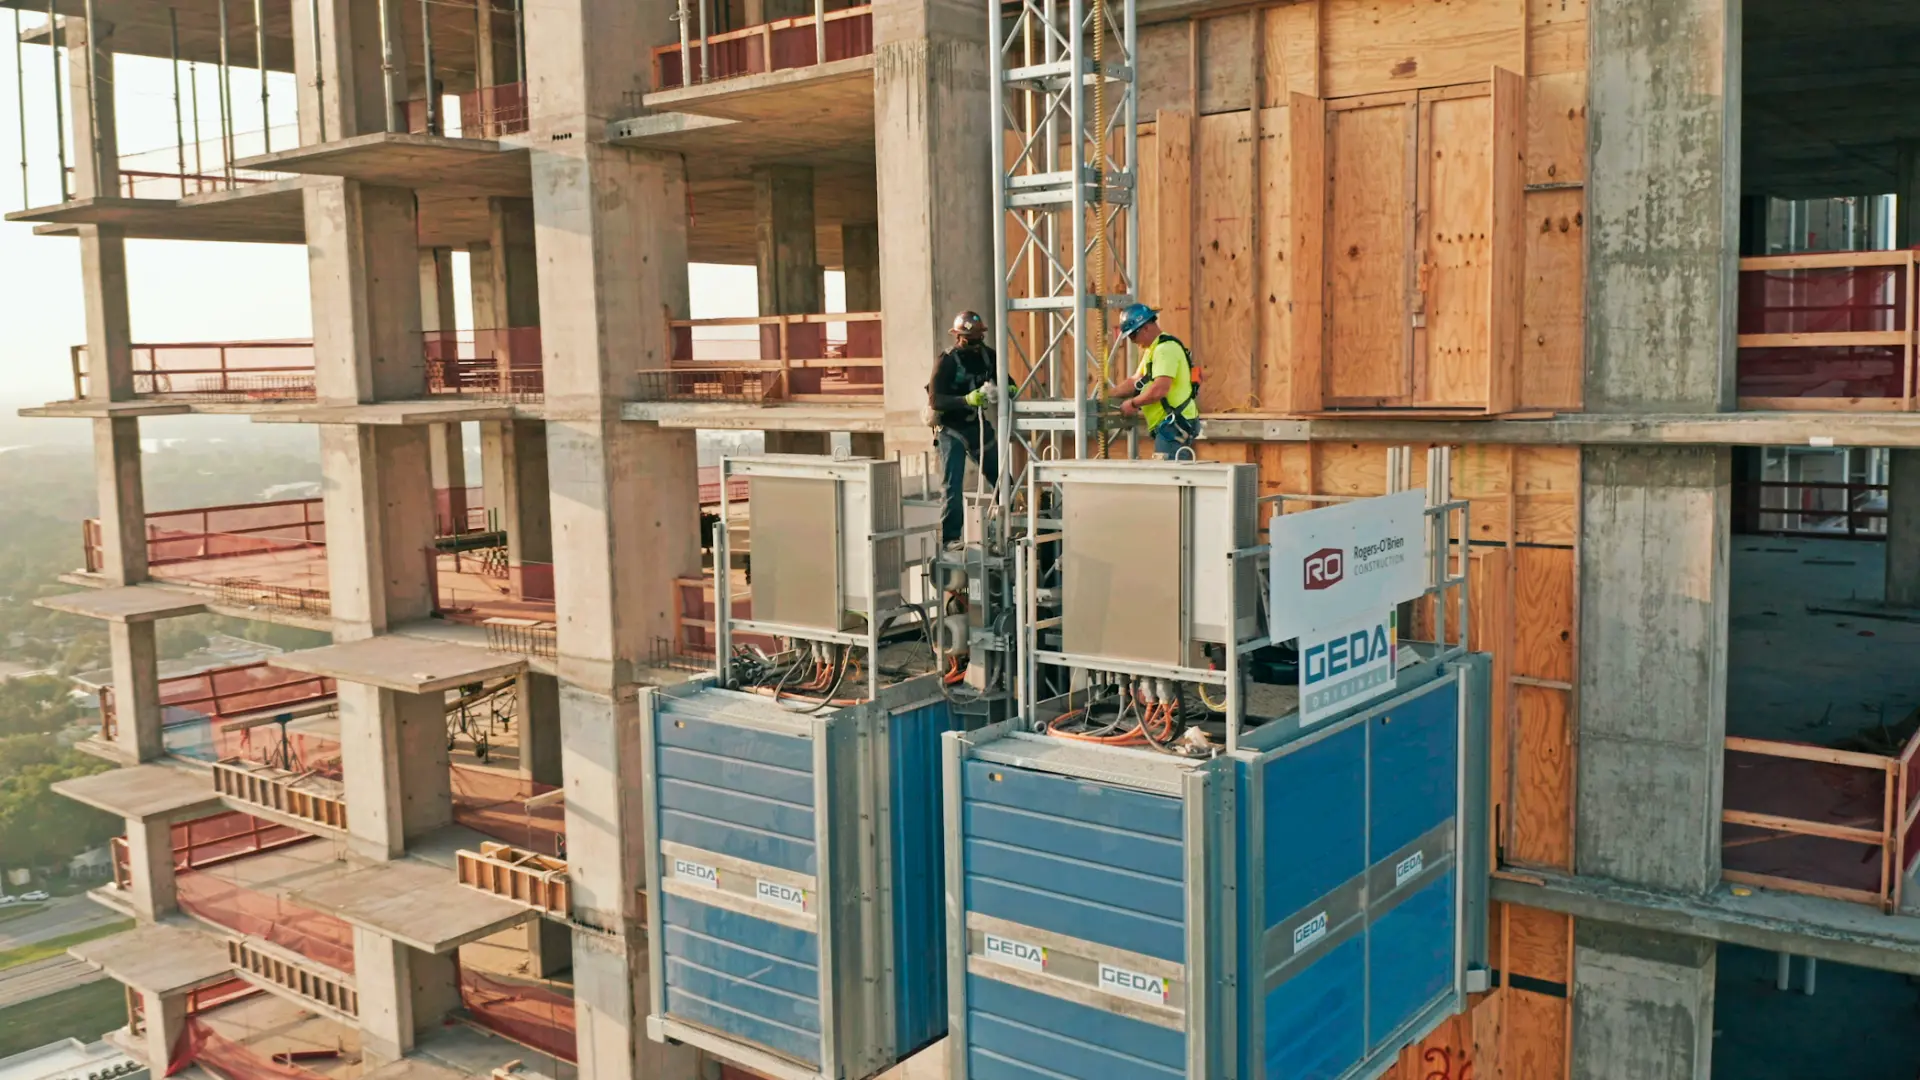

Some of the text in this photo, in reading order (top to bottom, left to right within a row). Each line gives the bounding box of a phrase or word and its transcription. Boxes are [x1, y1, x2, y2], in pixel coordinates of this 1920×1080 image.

[1354, 536, 1404, 561] Rogers-O'Brien
[1353, 554, 1404, 576] CONSTRUCTION
[1304, 623, 1388, 686] GEDA
[1311, 672, 1382, 709] ORIGINAL
[676, 860, 716, 881] GEDA
[1397, 854, 1421, 878] GEDA
[758, 881, 802, 903] GEDA
[1295, 915, 1326, 944] GEDA
[987, 936, 1041, 962] GEDA
[1101, 967, 1162, 994] GEDA
